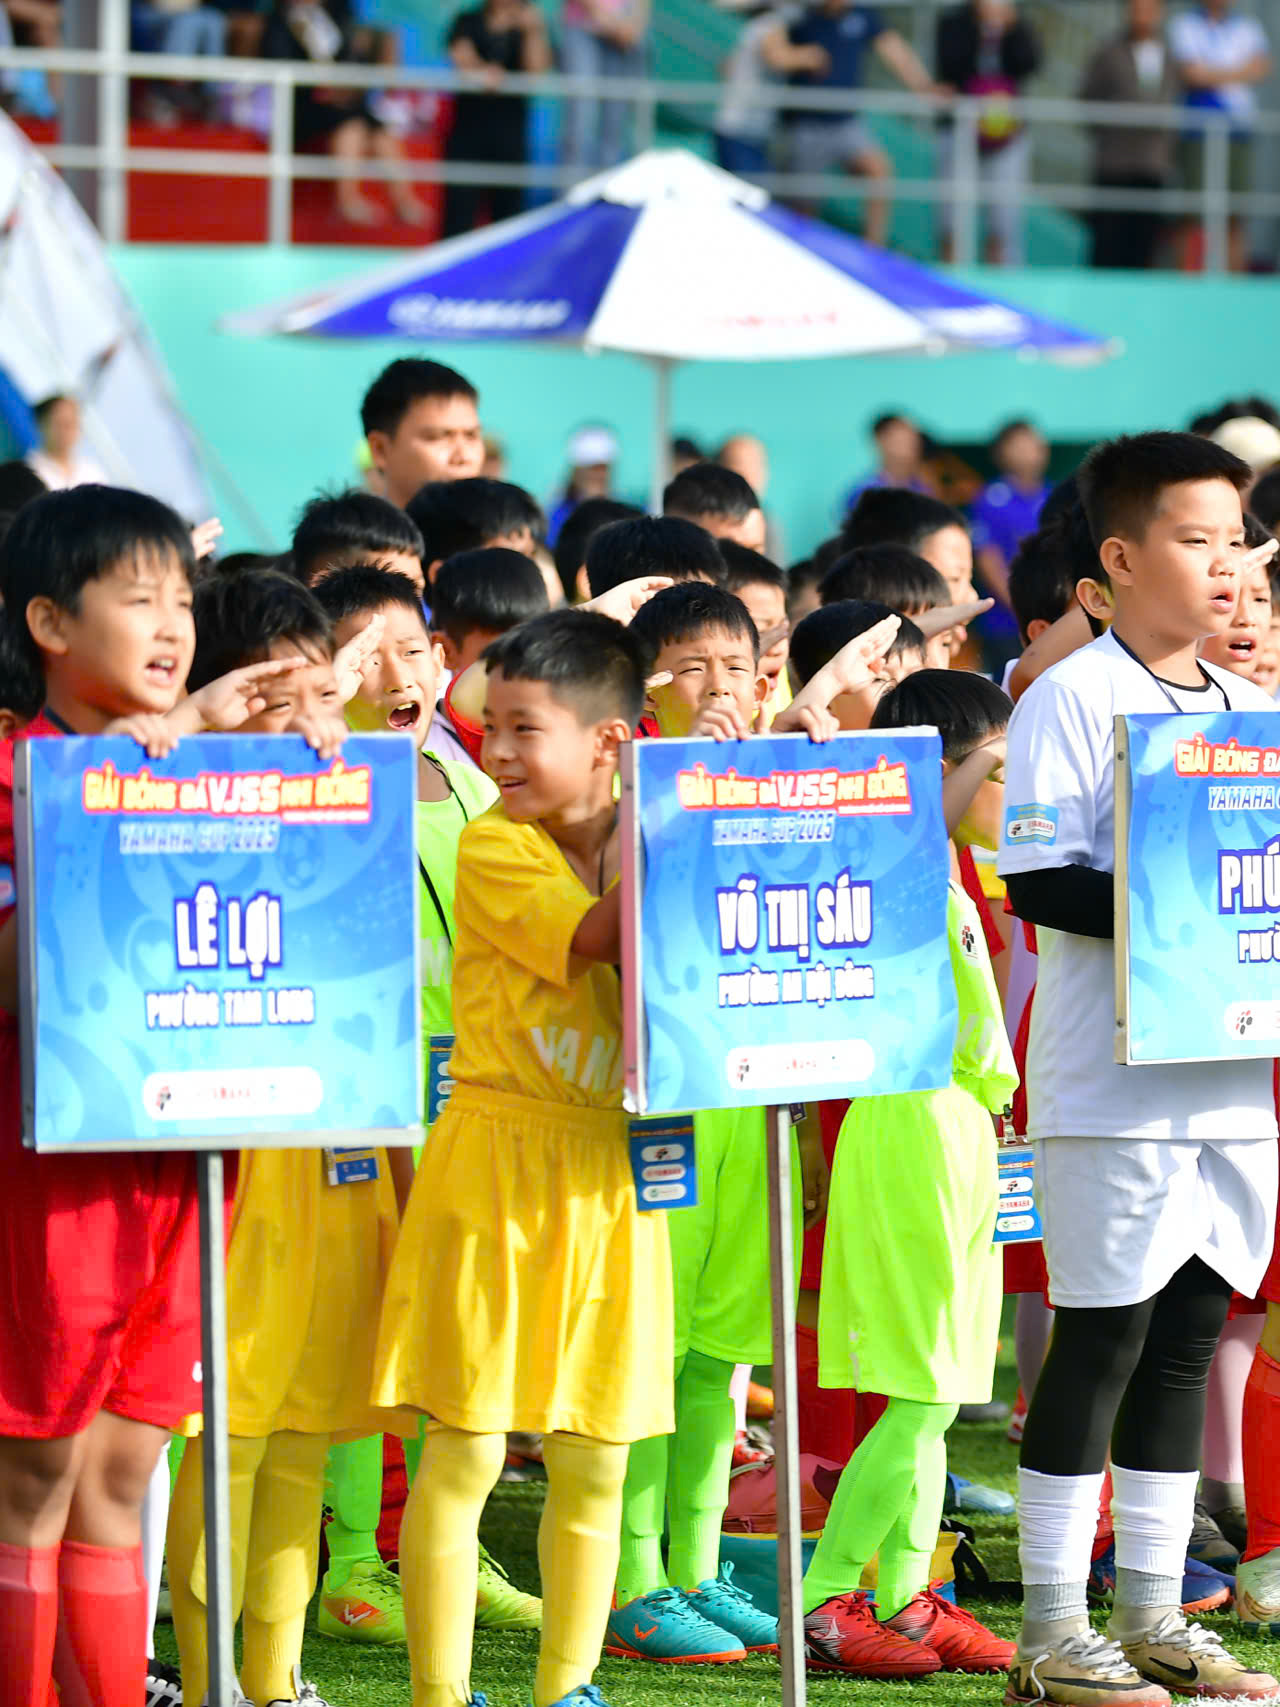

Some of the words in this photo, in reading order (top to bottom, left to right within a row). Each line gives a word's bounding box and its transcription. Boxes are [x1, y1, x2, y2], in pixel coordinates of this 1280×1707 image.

[1177, 737, 1210, 773] GIẢI
[1213, 742, 1260, 773] BÓNG
[208, 774, 281, 813] VJSS
[778, 772, 837, 807] VJSS
[1208, 786, 1274, 810] YAMAHA
[796, 811, 836, 842] 2025
[175, 884, 219, 967] LÊ
[227, 895, 281, 978] LỢI
[717, 878, 758, 950] VÕ
[765, 888, 809, 958] THỊ
[816, 873, 871, 944] SÁU
